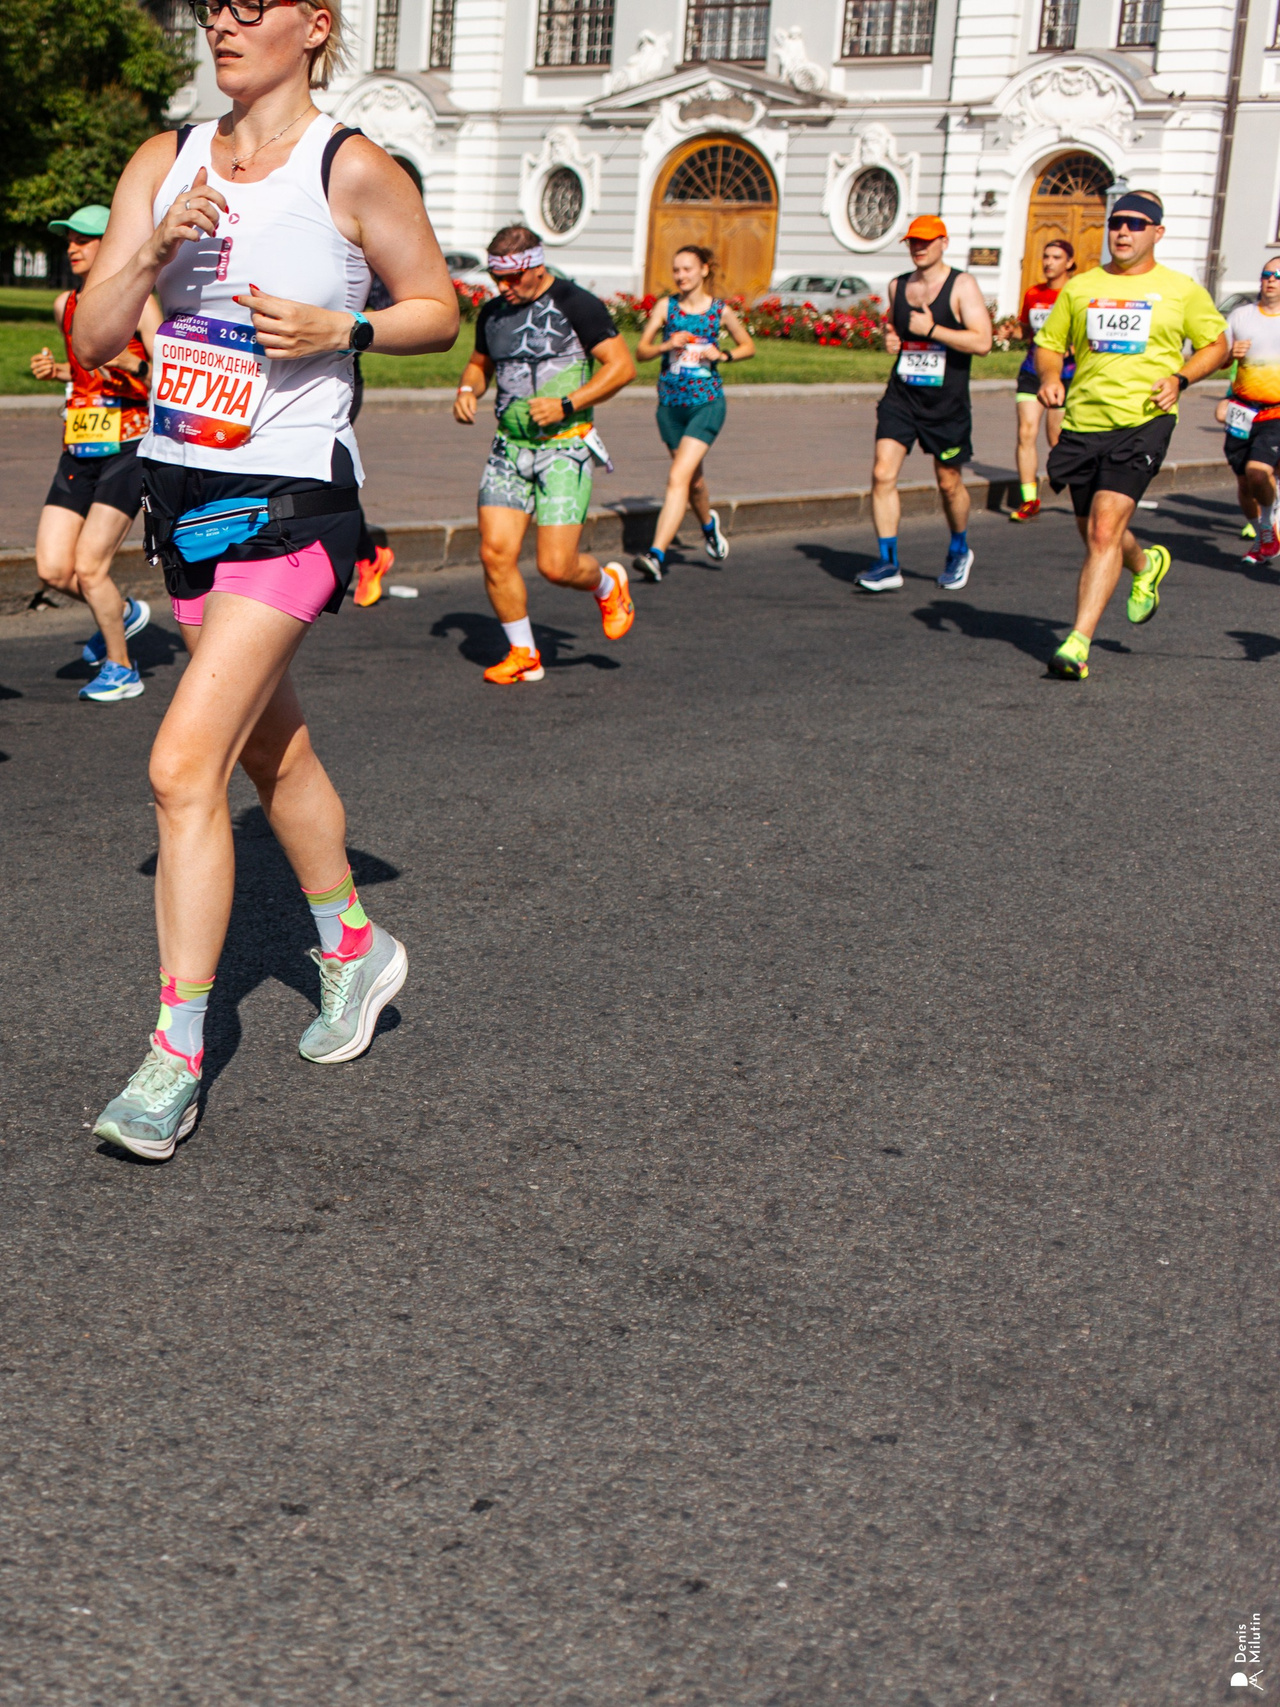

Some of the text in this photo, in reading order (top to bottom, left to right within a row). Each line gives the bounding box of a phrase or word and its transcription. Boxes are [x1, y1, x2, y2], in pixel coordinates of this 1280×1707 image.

[172, 321, 208, 335] МАРАФОН
[1097, 314, 1141, 331] 1482
[220, 328, 257, 344] 2026
[162, 344, 263, 378] СОПРОВОЖДЕНИЕ
[907, 353, 938, 368] 5243
[157, 362, 253, 418] БЕГУНА
[72, 413, 112, 432] 6476
